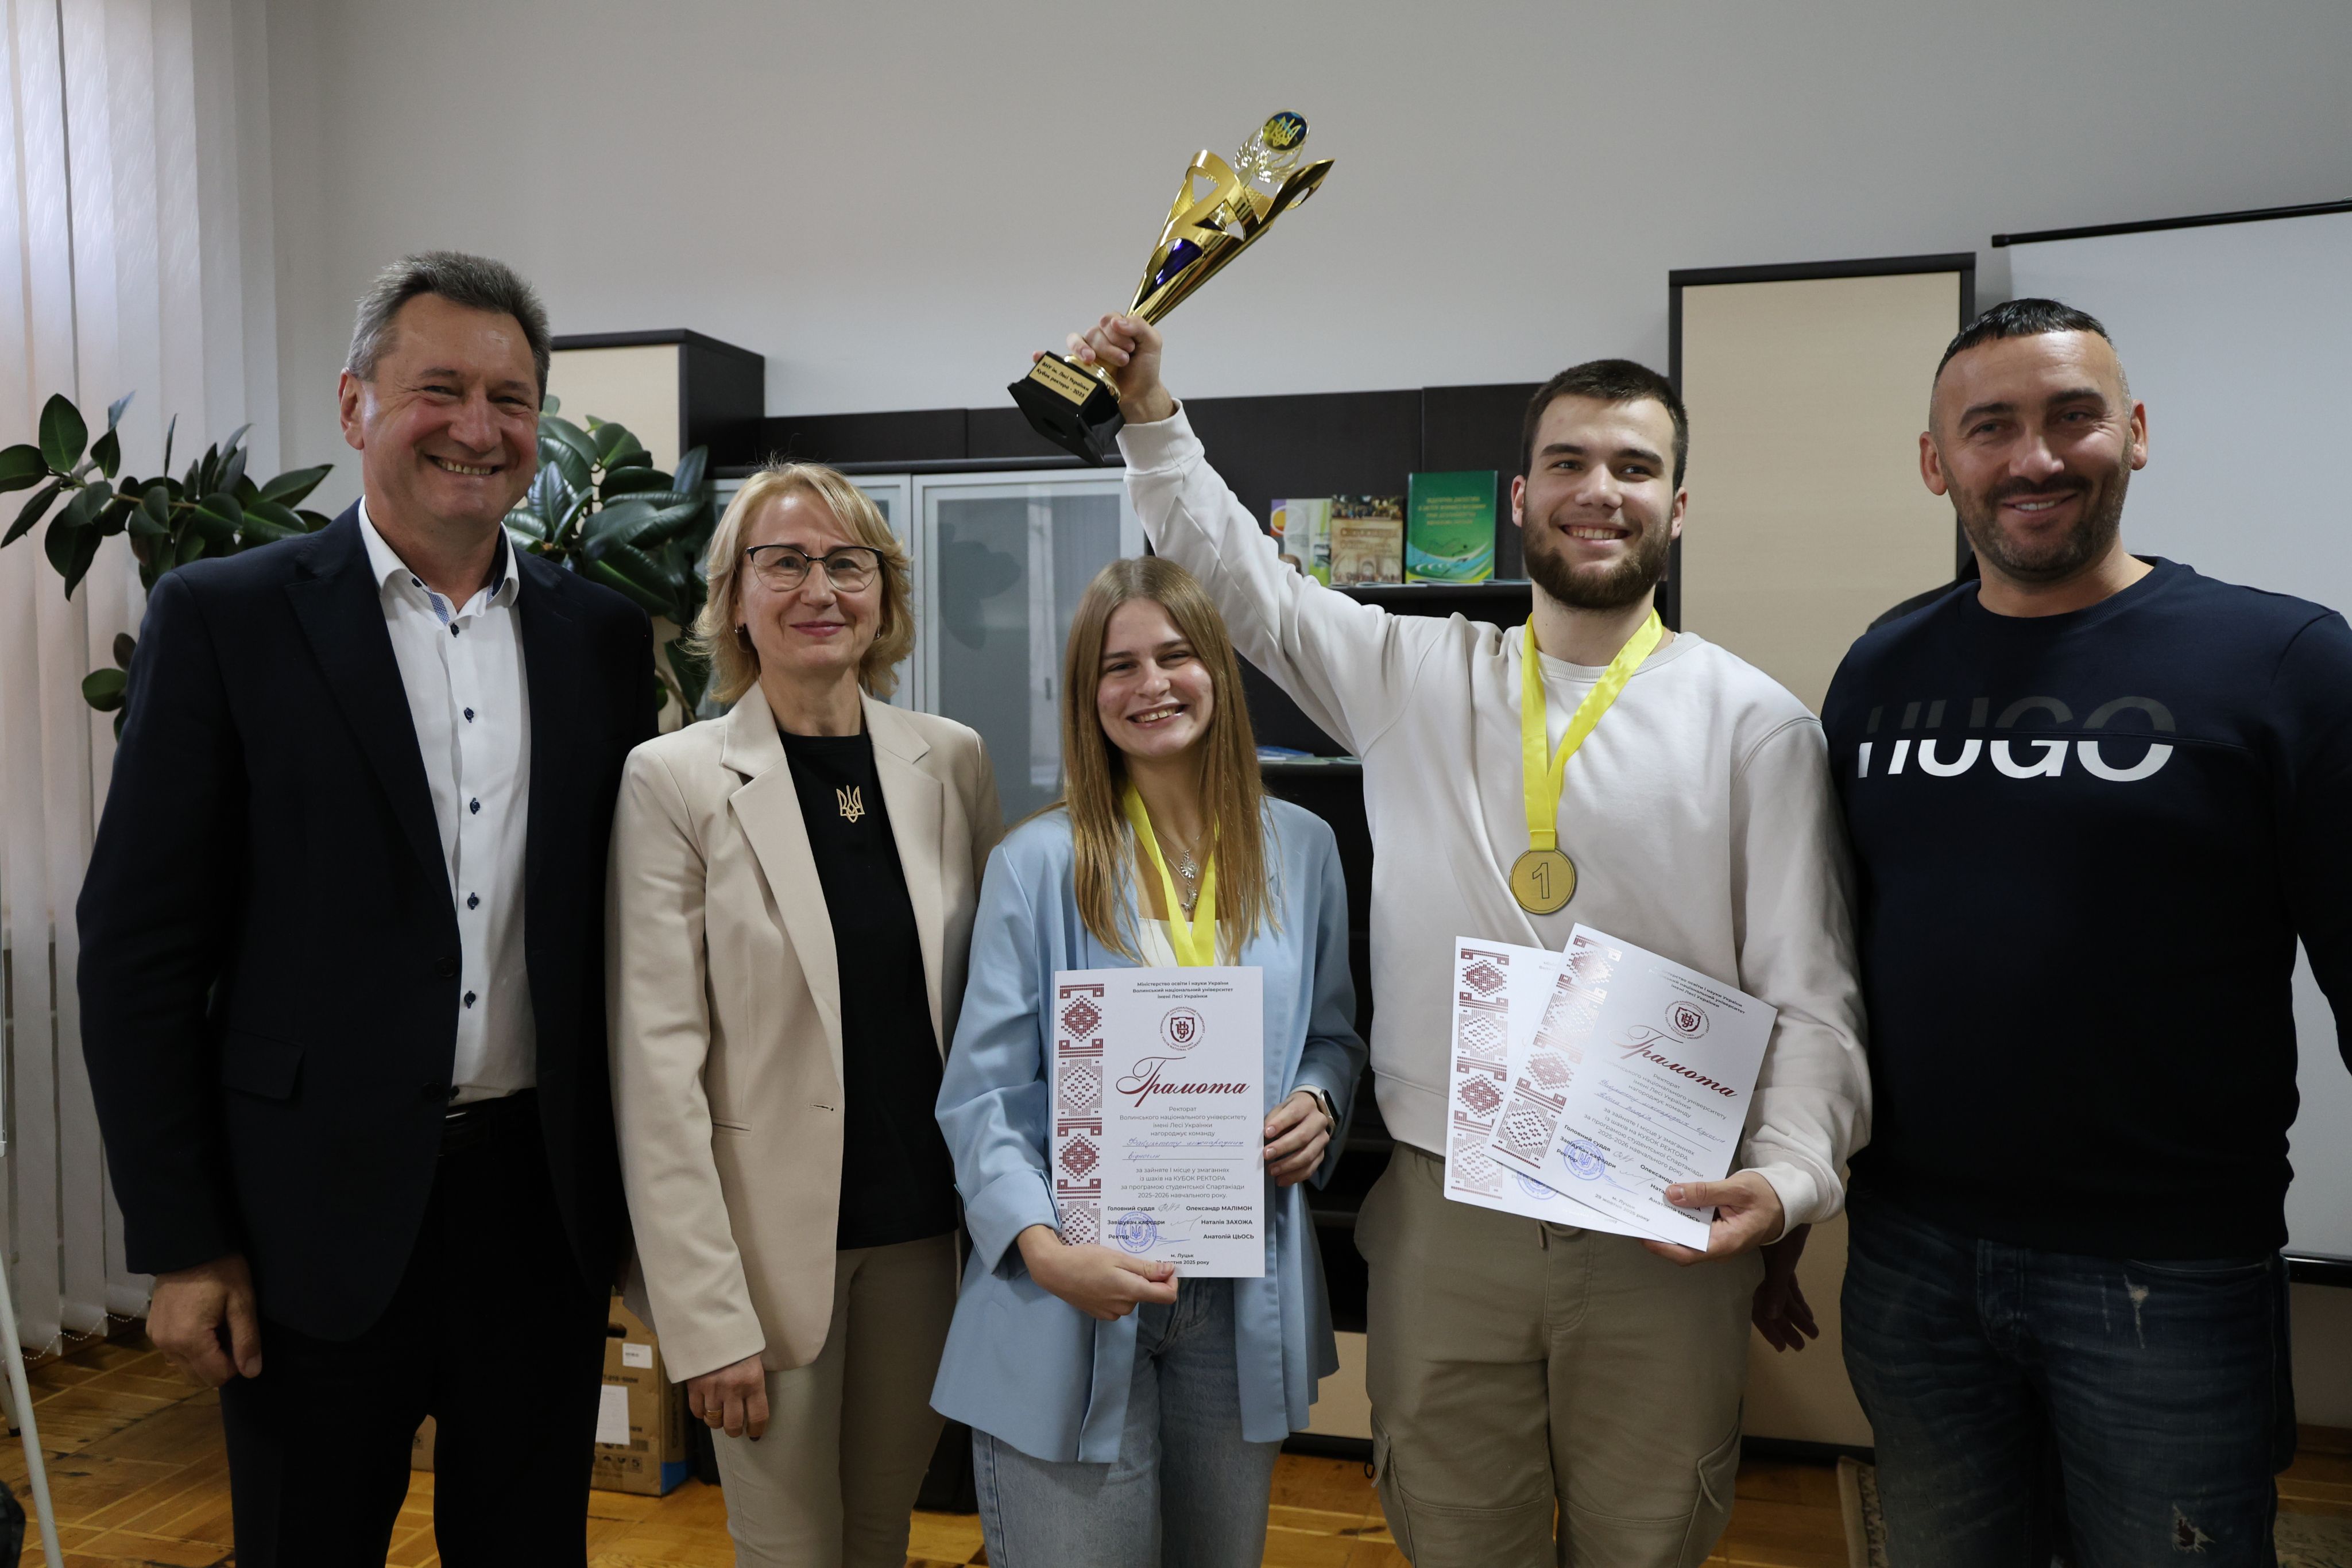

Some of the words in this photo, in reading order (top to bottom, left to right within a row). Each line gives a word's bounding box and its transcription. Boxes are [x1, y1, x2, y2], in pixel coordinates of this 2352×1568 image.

[1036, 369, 1050, 378] Кубок
[1050, 377, 1069, 389] ректора
[1070, 377, 1089, 392] Українки
[1858, 696, 2176, 781] HUGO
[1533, 862, 1550, 899] 1
[1671, 984, 1684, 992] імені
[1684, 989, 1696, 997] Лесі
[1696, 994, 1719, 1008] Українки
[1680, 982, 1714, 1000] національний
[1715, 998, 1744, 1015] університет
[1687, 979, 1703, 990] освіти
[1707, 989, 1722, 999] науки
[1722, 995, 1742, 1008] України
[1607, 1025, 1738, 1098] Грамота
[1116, 1056, 1250, 1107] Грамота
[1633, 1078, 1649, 1089] імені
[1650, 1086, 1663, 1097] Лесі
[1664, 1093, 1690, 1112] Українки
[1653, 1073, 1680, 1090] Ректорат
[1628, 1083, 1664, 1105] нагороджує
[1665, 1102, 1691, 1118] команду
[1642, 1075, 1686, 1100] національного
[1687, 1097, 1726, 1121] університету
[1564, 1124, 1592, 1143] Головний
[1592, 1139, 1611, 1153] суддя
[1591, 1118, 1626, 1139] програмою
[1627, 1135, 1665, 1159] студентської
[1666, 1155, 1703, 1179] Спартакіади
[1611, 1110, 1635, 1126] зайняте
[1639, 1124, 1657, 1138] місце
[1662, 1136, 1695, 1156] змаганнях
[1611, 1118, 1628, 1130] шахів
[1638, 1132, 1659, 1146] КУБОК
[1659, 1143, 1688, 1162] РЕКТОРА
[1556, 1148, 1577, 1163] Ректор
[1560, 1135, 1589, 1156] Завідувач
[1589, 1151, 1616, 1169] кафедри
[1629, 1145, 1668, 1168] навчального
[1640, 1163, 1673, 1185] Олександр
[1650, 1183, 1666, 1195] Ната
[1637, 1212, 1649, 1222] року
[1649, 1195, 1677, 1213] Анатолій
